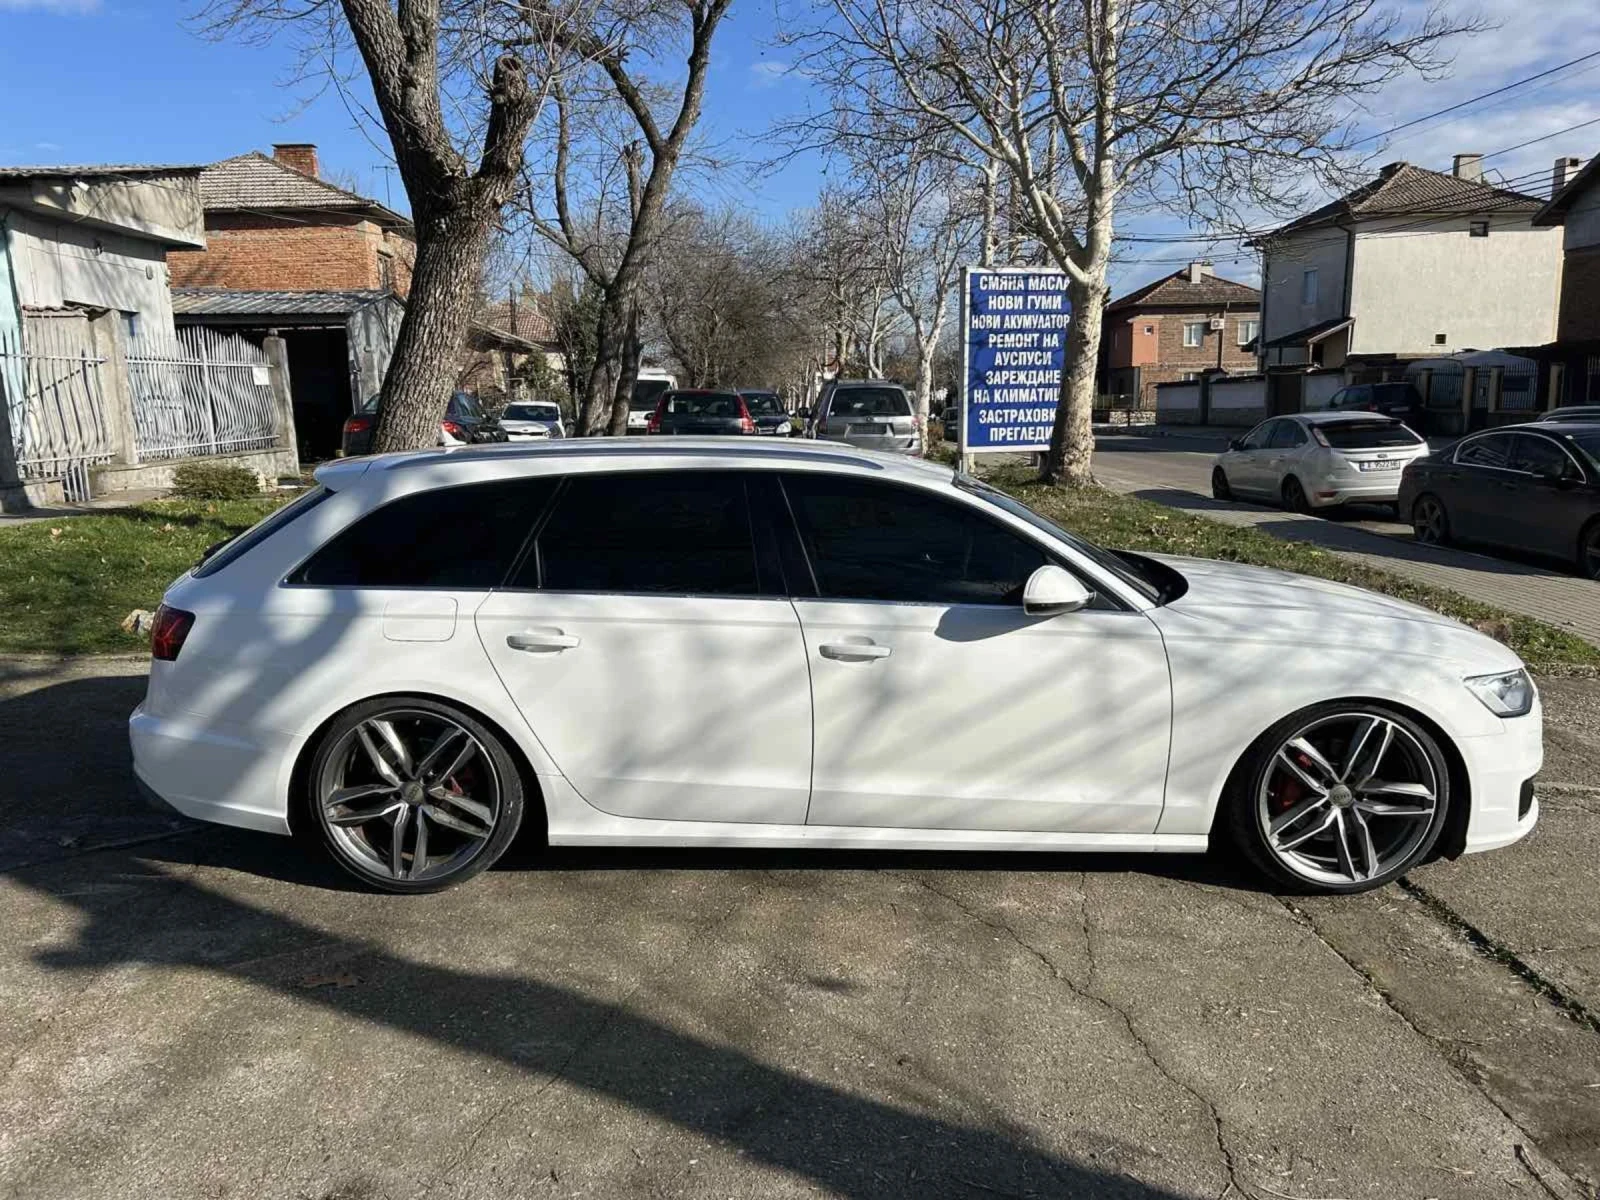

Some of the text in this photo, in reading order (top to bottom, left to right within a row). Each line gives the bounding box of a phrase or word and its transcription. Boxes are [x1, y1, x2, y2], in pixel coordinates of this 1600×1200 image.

[980, 275, 1024, 290] СМЯНА
[989, 296, 1061, 309] НОВИ ГУМИ
[972, 315, 1000, 329] НОВИ
[989, 334, 1059, 347] РЕМОНТ НА
[995, 352, 1052, 365] АУСПУСИ
[986, 370, 1060, 386] ЗАРЕЖДАНЕ
[974, 390, 990, 403] НА
[990, 426, 1054, 442] ПРЕГЛЕДИ
